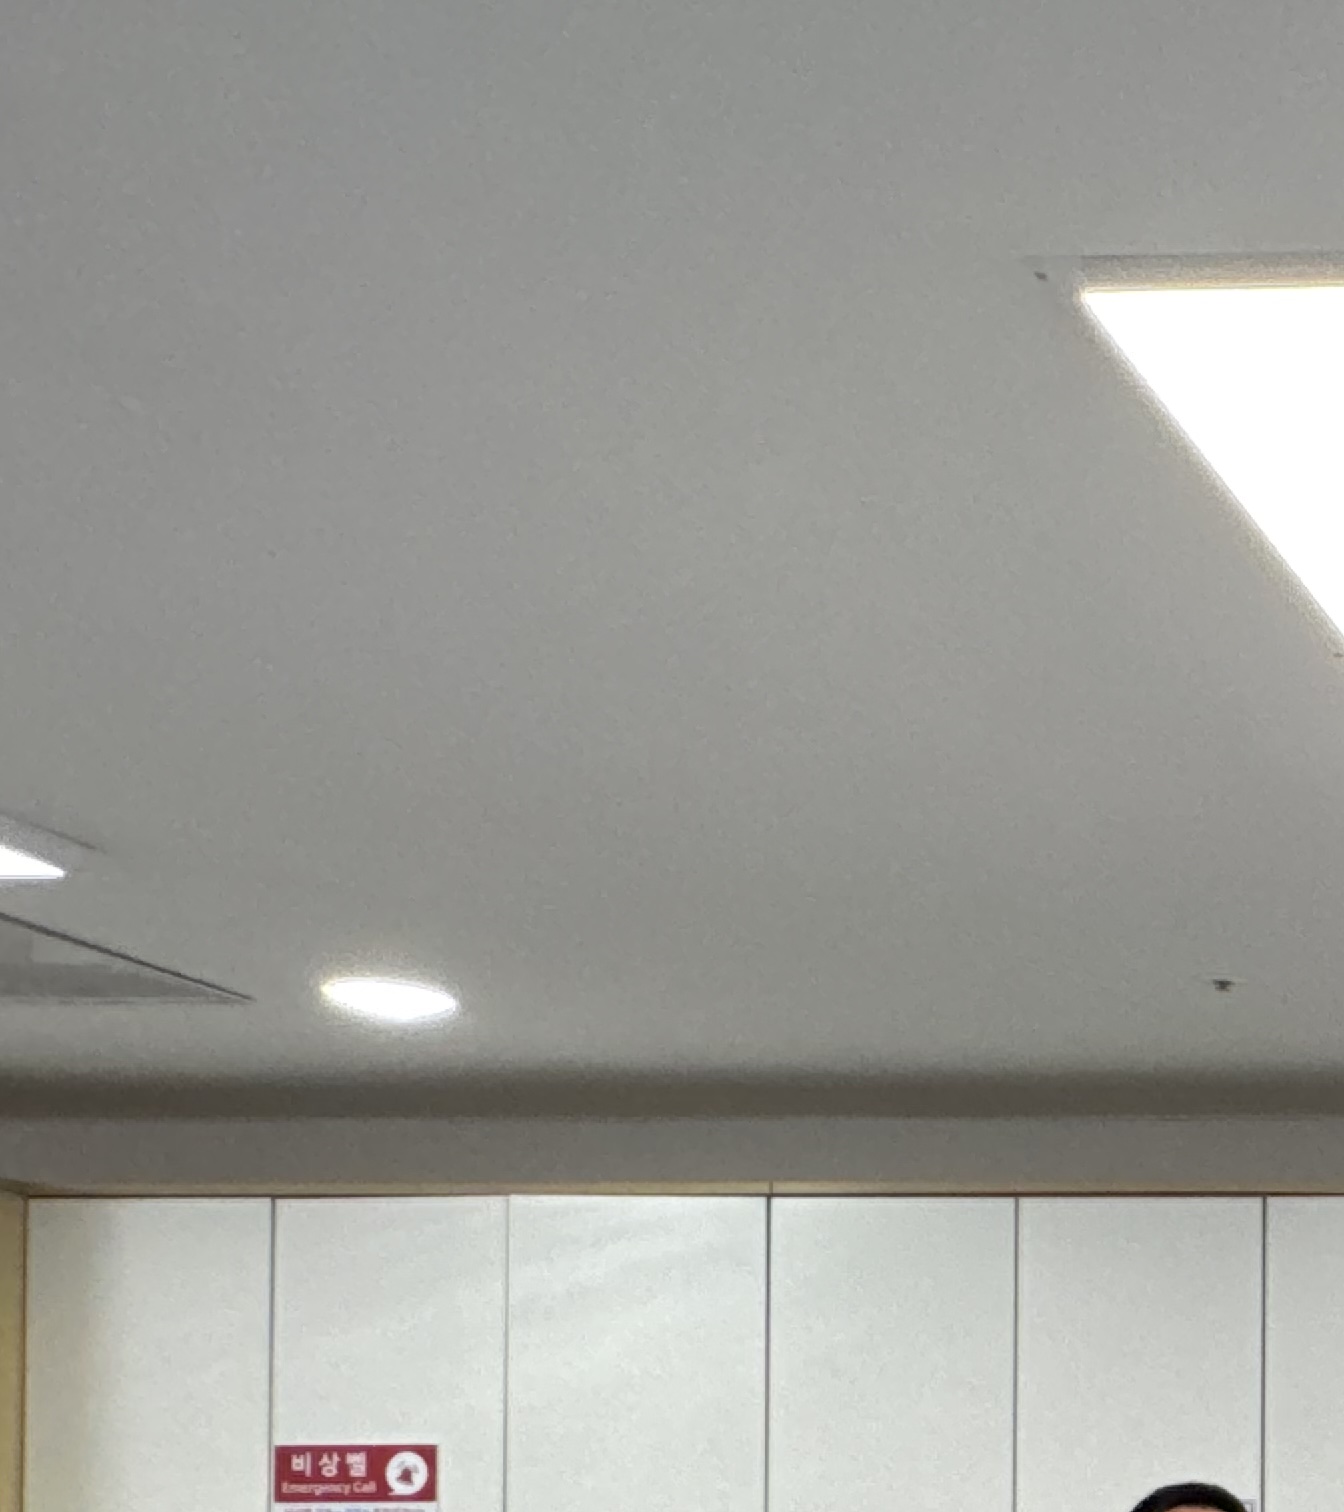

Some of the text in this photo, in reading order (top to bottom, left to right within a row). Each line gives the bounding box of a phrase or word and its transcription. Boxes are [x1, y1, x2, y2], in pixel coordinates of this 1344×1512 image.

[291, 1451, 368, 1478] 비상벨
[281, 1480, 377, 1496] Emergency Call
